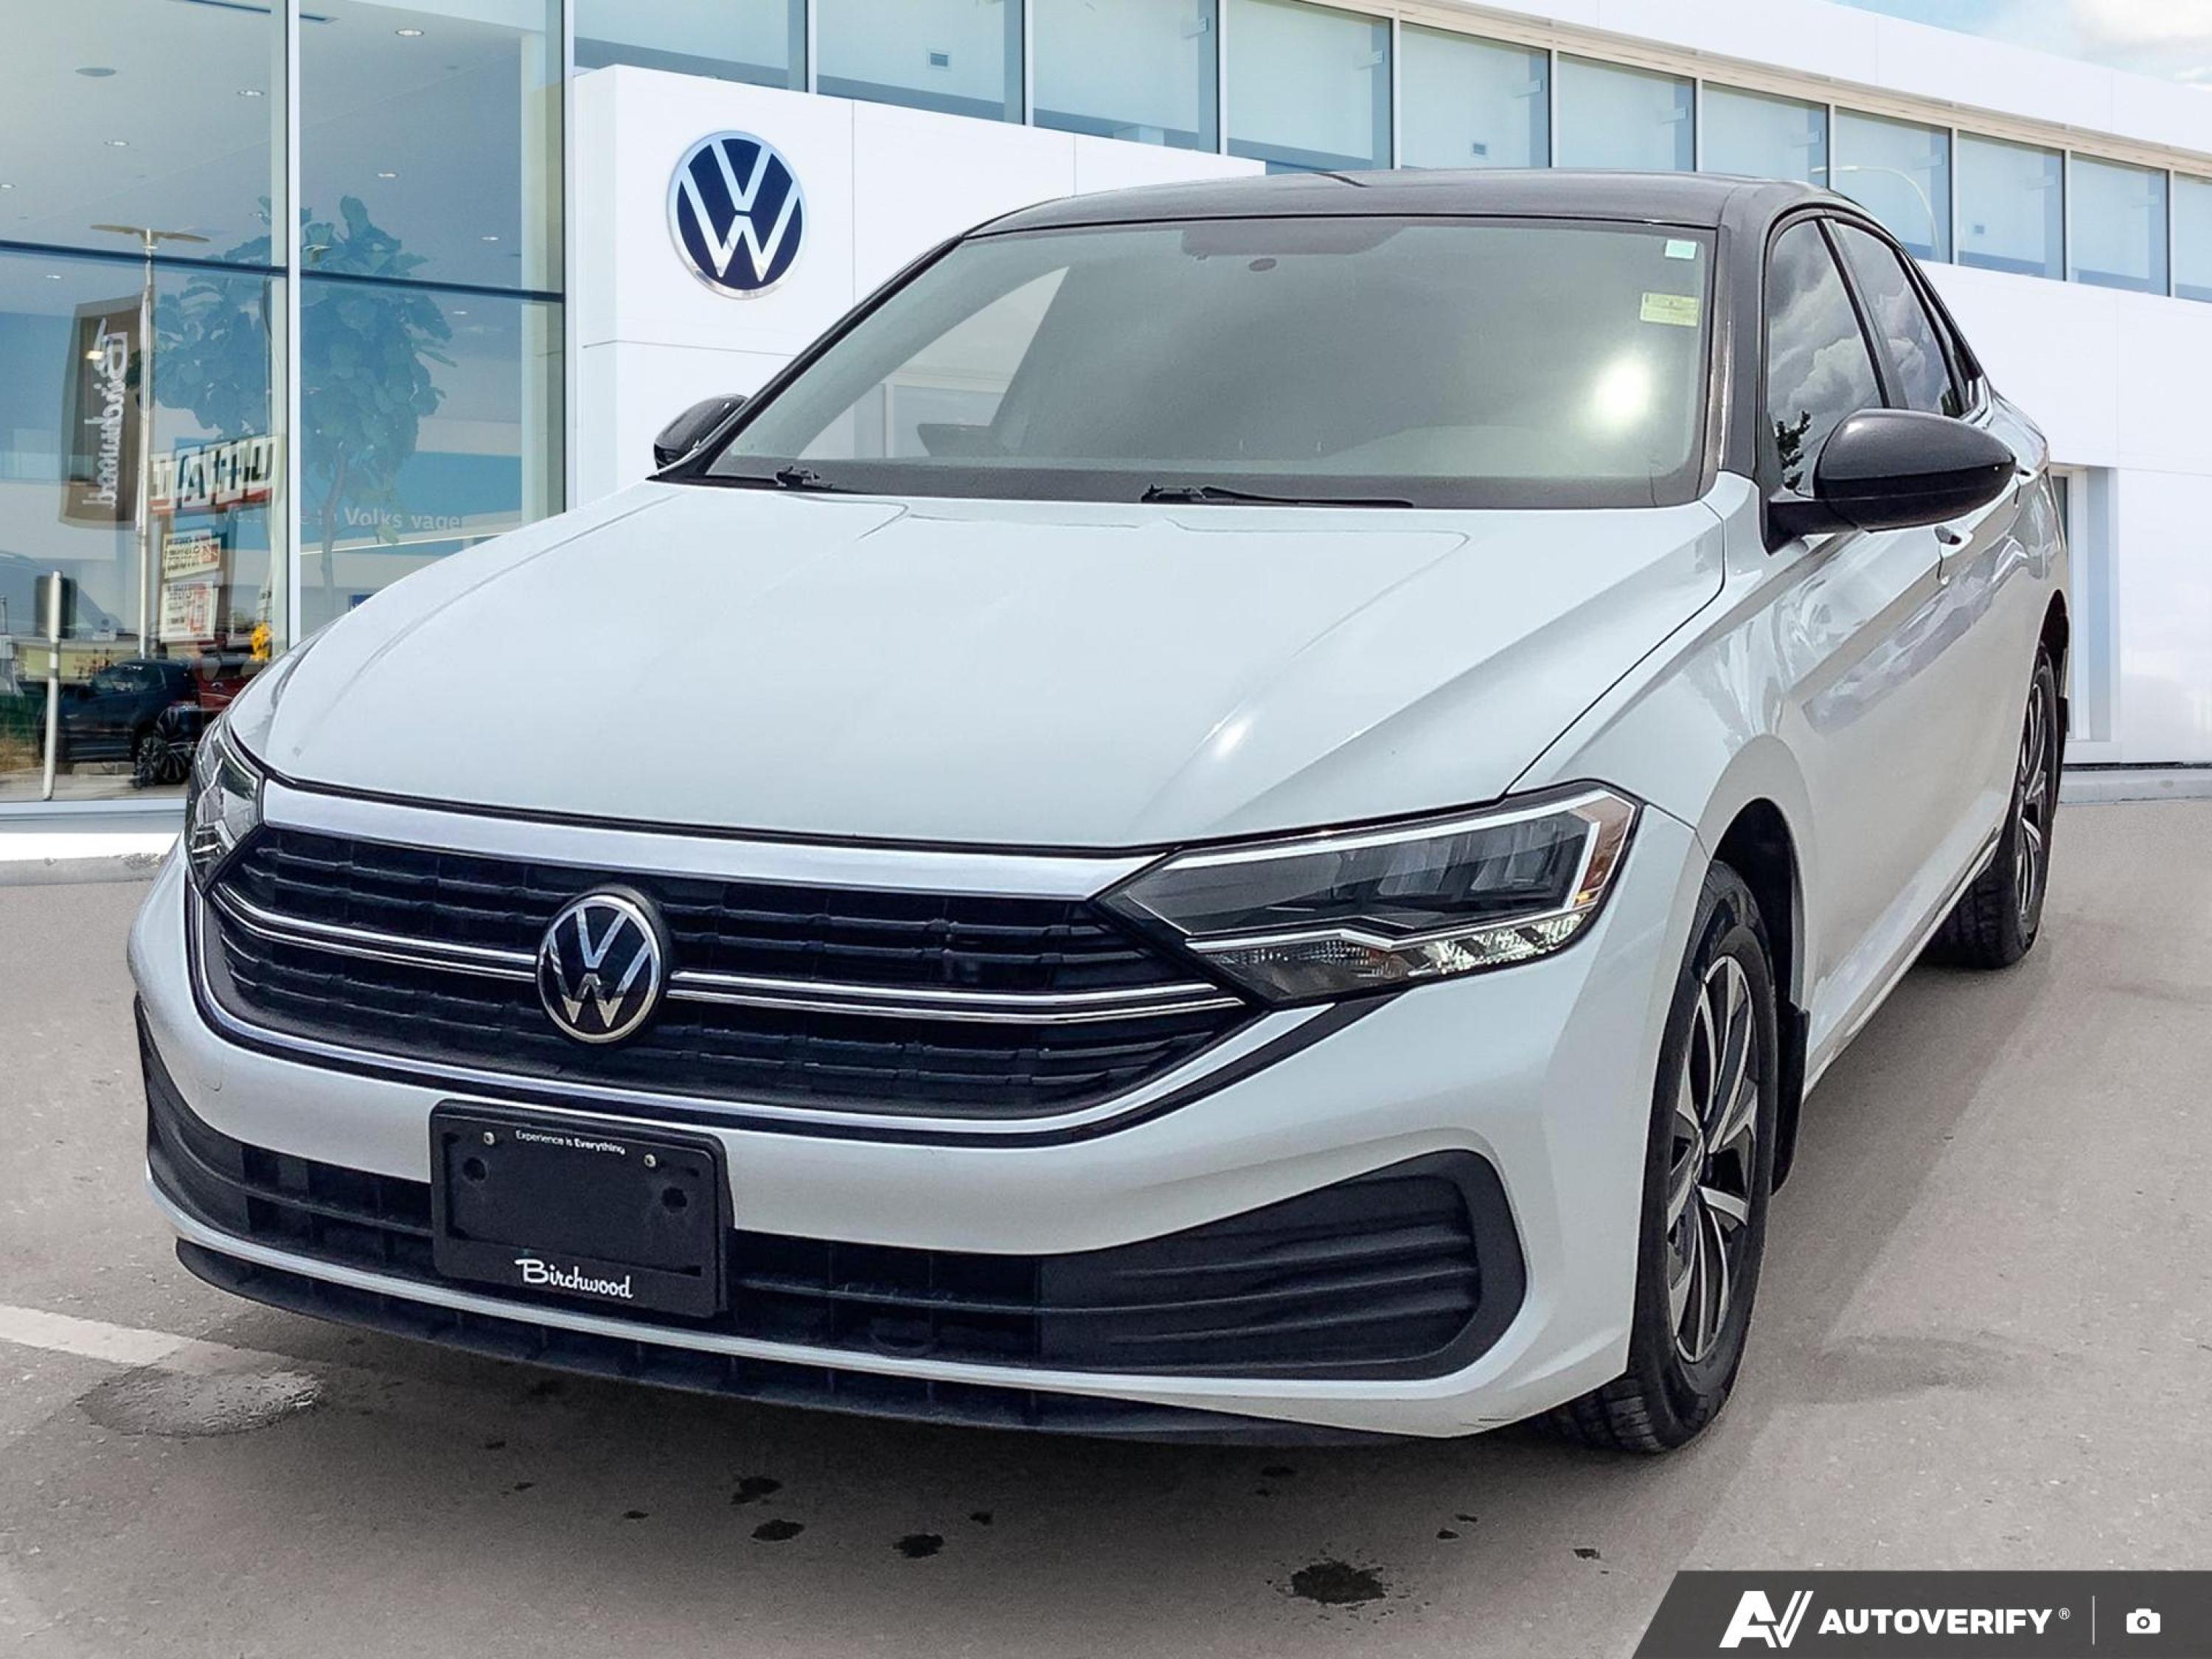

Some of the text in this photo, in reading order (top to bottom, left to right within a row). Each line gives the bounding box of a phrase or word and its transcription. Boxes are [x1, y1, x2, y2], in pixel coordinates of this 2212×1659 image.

[675, 137, 802, 285] VW
[546, 904, 653, 1029] VW
[515, 1130, 625, 1155] Experience is Everything
[514, 1259, 633, 1298] Birchwood
